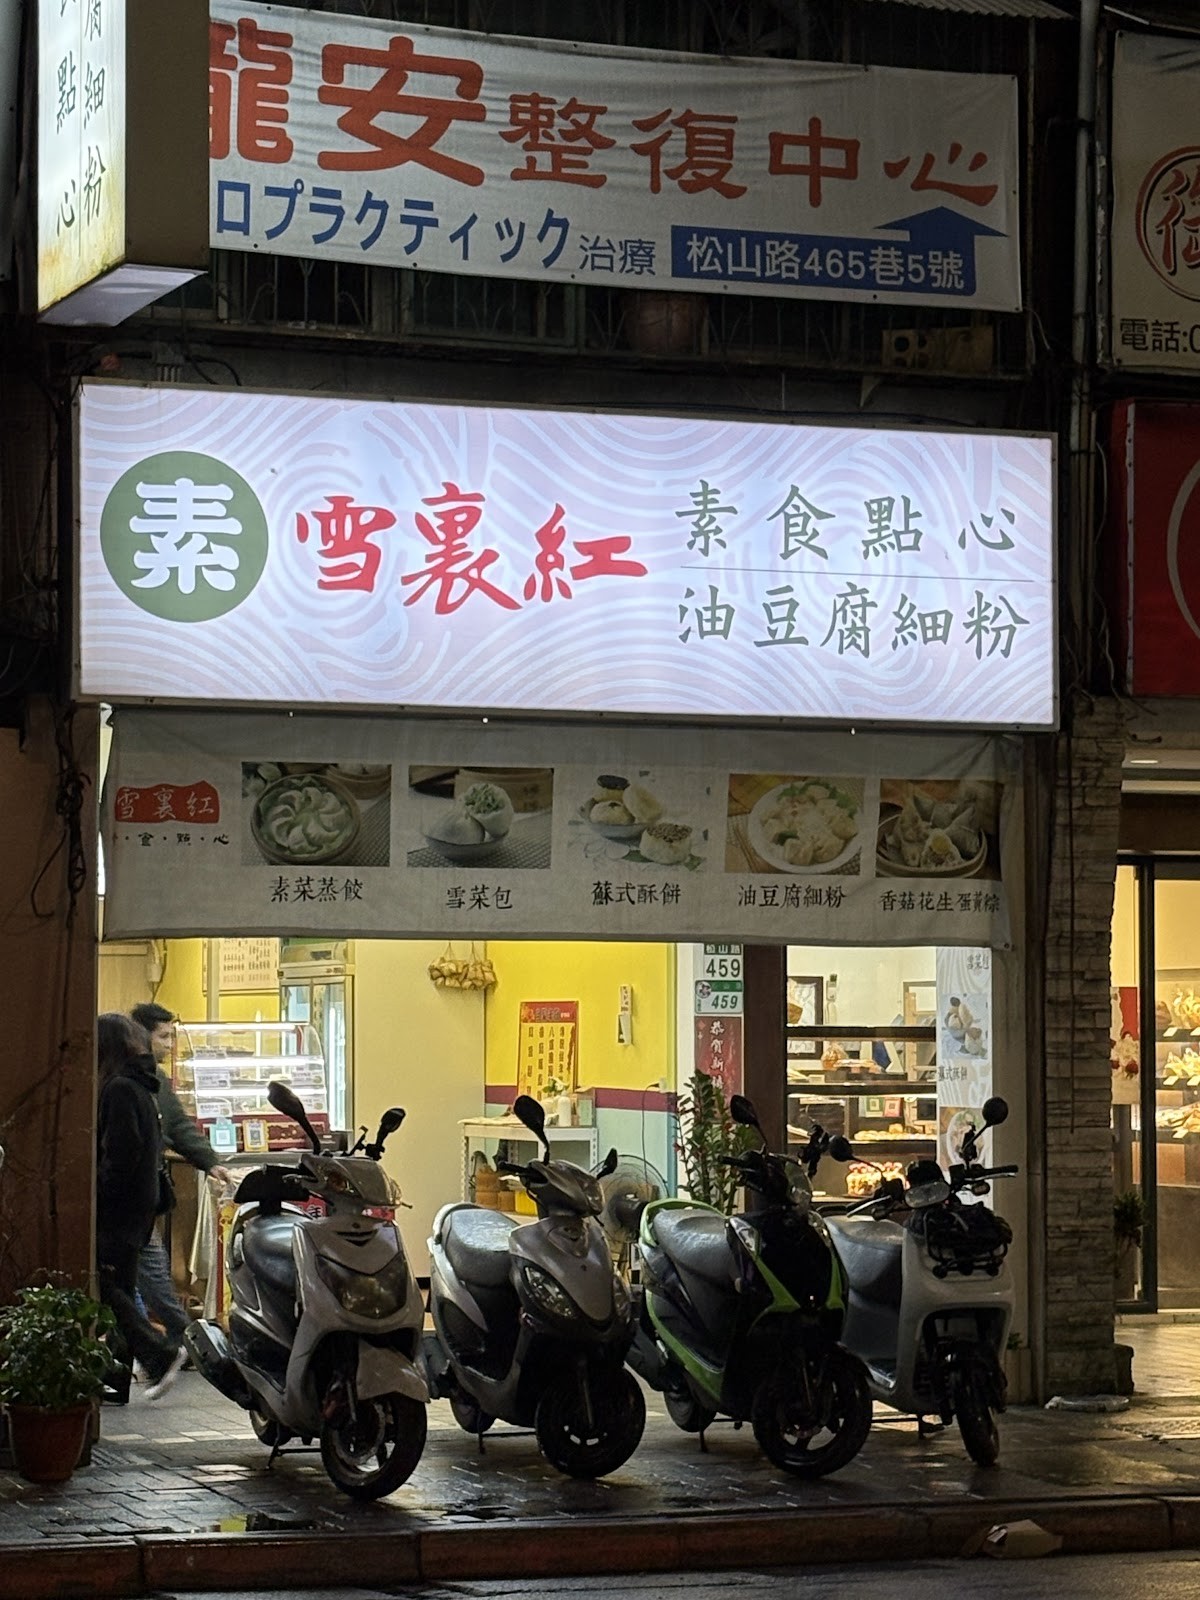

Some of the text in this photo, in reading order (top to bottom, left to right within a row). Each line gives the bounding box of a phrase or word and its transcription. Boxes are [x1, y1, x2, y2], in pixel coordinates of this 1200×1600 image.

[686, 232, 965, 291] 松山路465巷5號
[674, 479, 1016, 561] 素食點心
[128, 477, 243, 595] 素
[295, 481, 649, 616] 雪裏紅
[677, 581, 1031, 661] 油豆腐細粉
[117, 787, 215, 820] 雪裏紅
[269, 875, 364, 904] 素菜蒸餃
[445, 884, 514, 911] 雪菜包
[591, 880, 682, 906] 蘇式酥餅
[737, 883, 848, 911] 油豆腐細粉
[706, 958, 741, 978] 459
[711, 994, 739, 1010] 459
